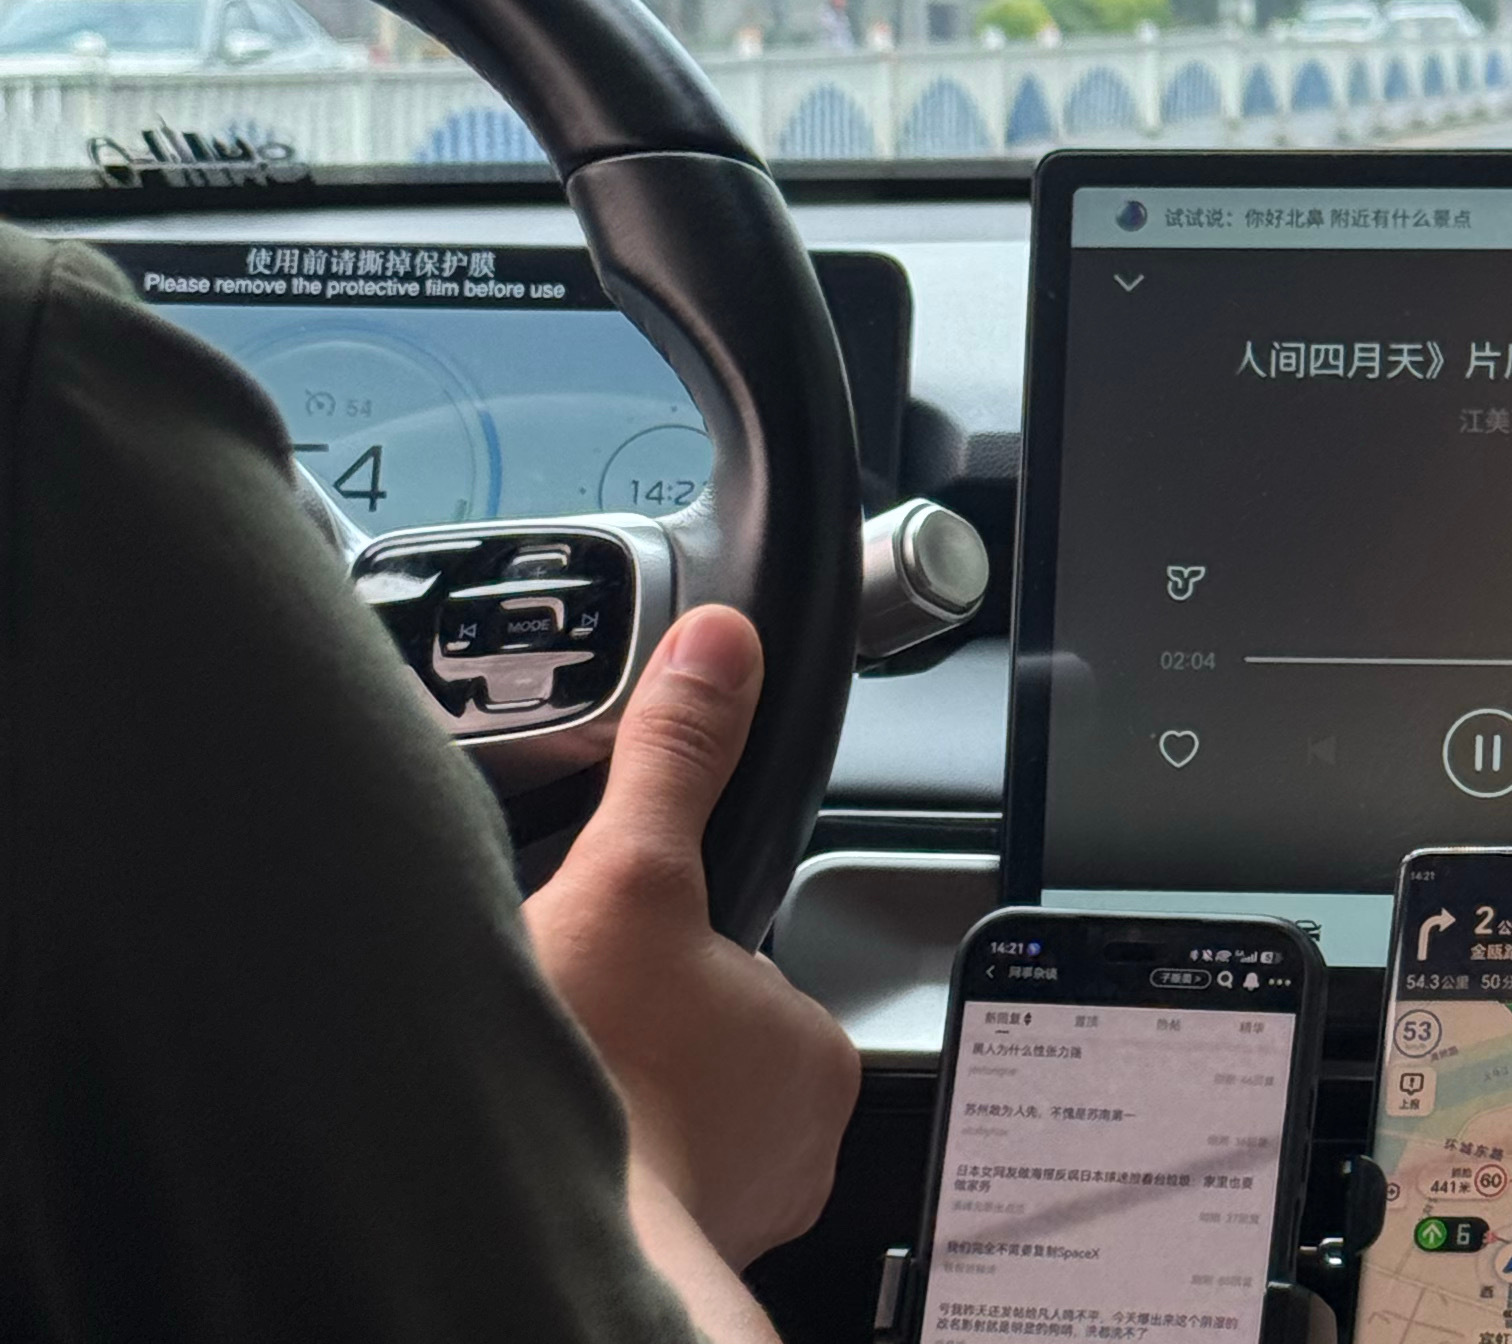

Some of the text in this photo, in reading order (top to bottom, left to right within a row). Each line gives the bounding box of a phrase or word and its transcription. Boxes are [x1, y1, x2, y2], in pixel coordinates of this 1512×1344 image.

[246, 246, 497, 278] 使用前请撕掉保护膜
[144, 272, 566, 300] Please remove the protective film before use
[630, 478, 708, 508] 14:2
[508, 618, 551, 634] MODE
[1160, 651, 1216, 671] 02:04
[990, 941, 1024, 956] 14:21
[1403, 1020, 1432, 1042] 53
[1480, 1172, 1503, 1189] 60
[1456, 1223, 1471, 1246] 6
